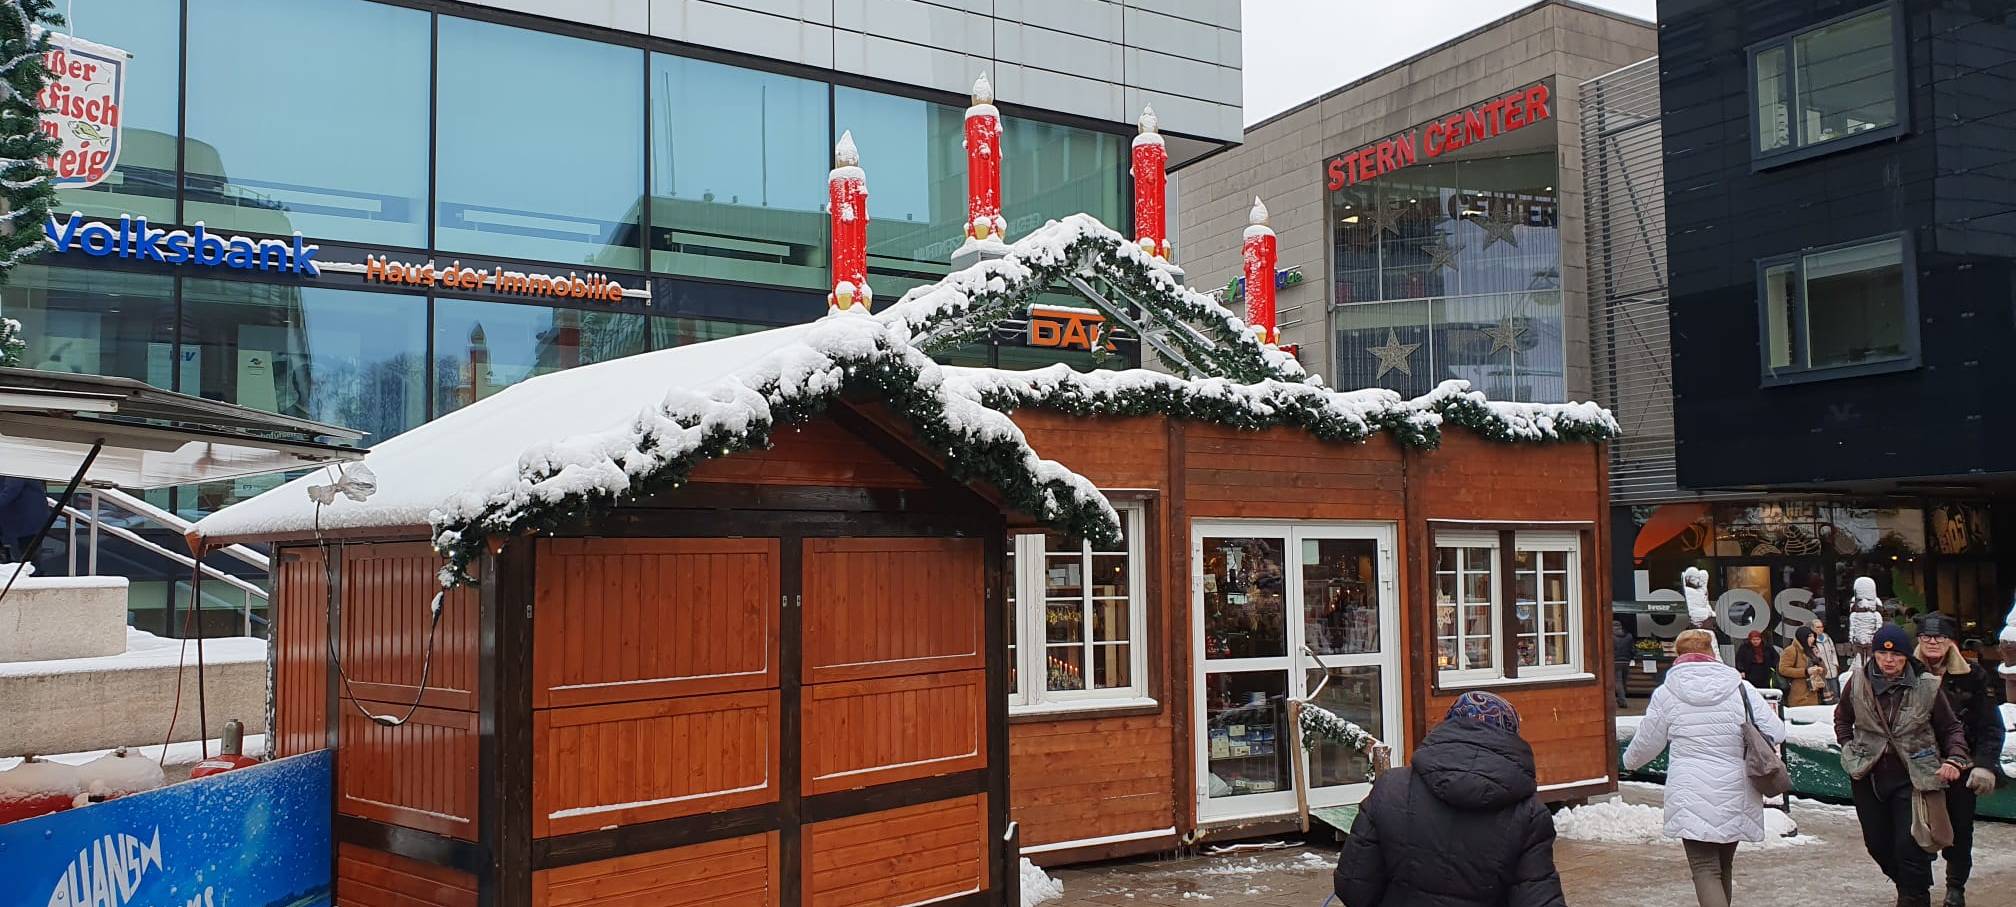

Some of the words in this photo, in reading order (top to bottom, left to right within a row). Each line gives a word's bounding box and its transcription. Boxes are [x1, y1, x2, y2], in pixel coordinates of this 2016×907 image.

[1328, 130, 1416, 191] STERN
[1423, 83, 1550, 158] CENTER
[44, 212, 320, 277] Volksbank
[366, 254, 435, 287] Haus
[442, 261, 488, 291] der
